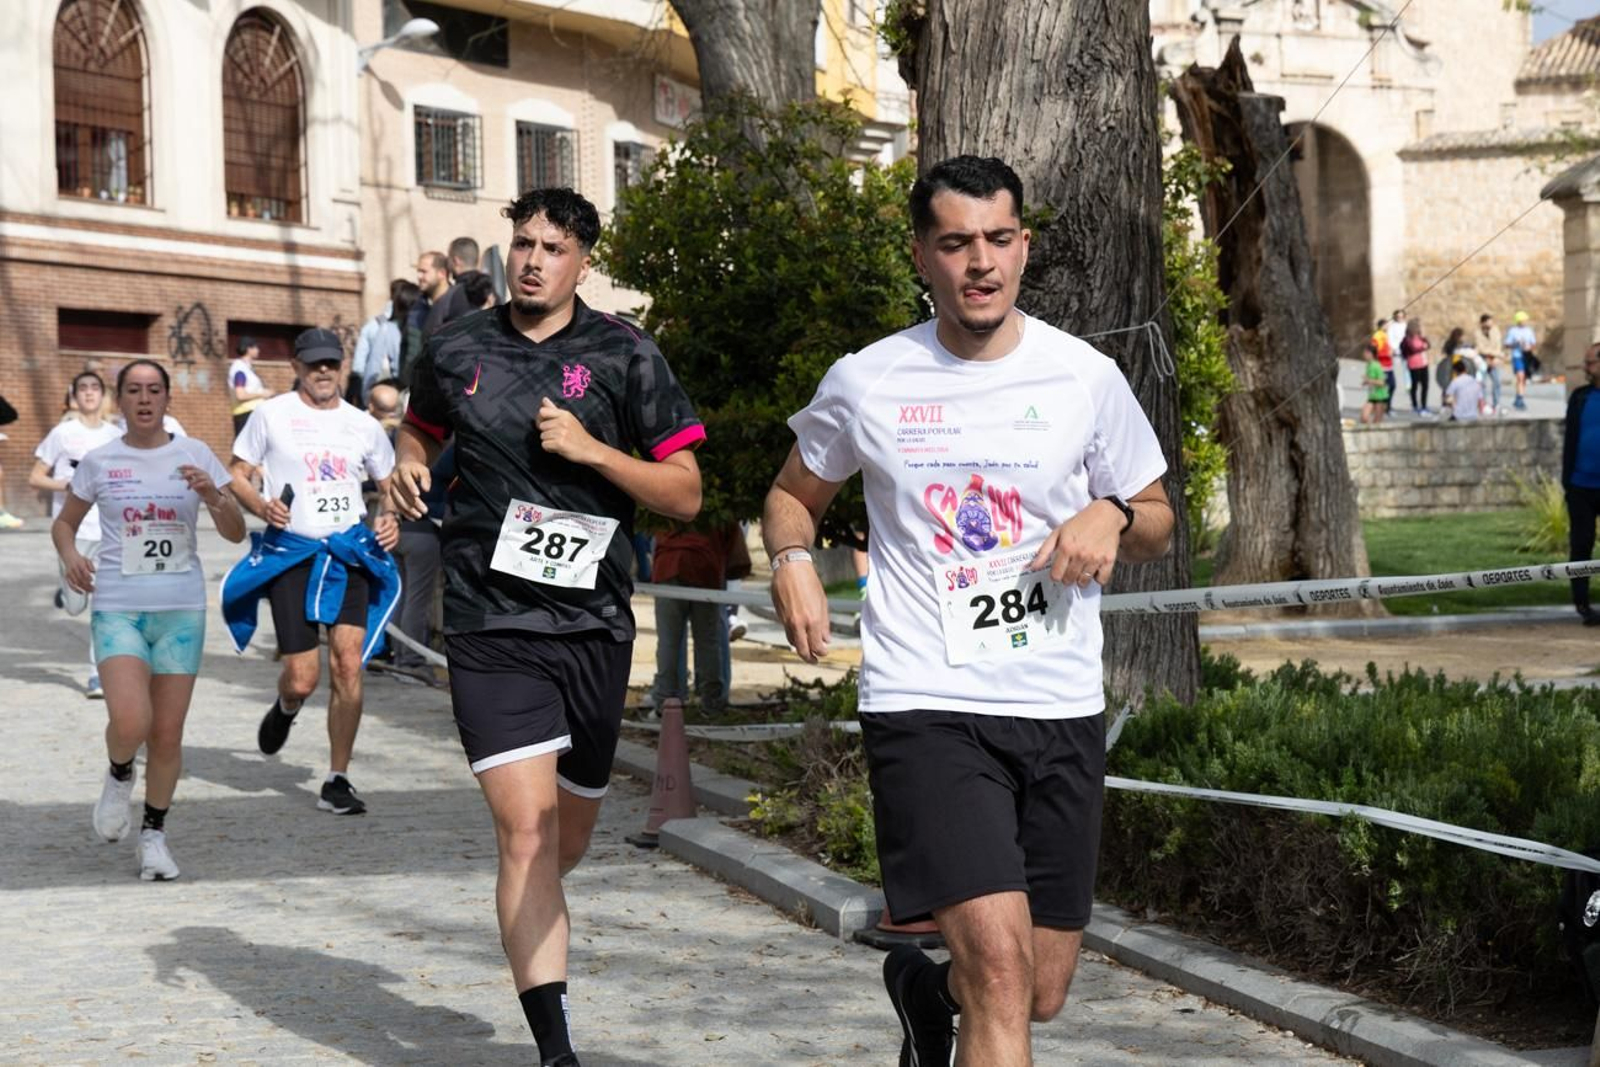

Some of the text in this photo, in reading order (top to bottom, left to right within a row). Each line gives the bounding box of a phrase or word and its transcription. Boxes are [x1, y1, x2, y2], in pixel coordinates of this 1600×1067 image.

[899, 405, 944, 424] XXVII
[897, 427, 962, 436] CARRERA POPULAR
[926, 459, 941, 468] cada
[316, 496, 350, 512] 233
[143, 539, 173, 558] 20
[519, 527, 590, 562] 287
[1308, 587, 1353, 602] DEPORTES
[1377, 582, 1426, 596] Ayuntamiento
[1426, 579, 1437, 591] de
[1482, 569, 1533, 586] DEPORTES
[969, 581, 1049, 631] 284
